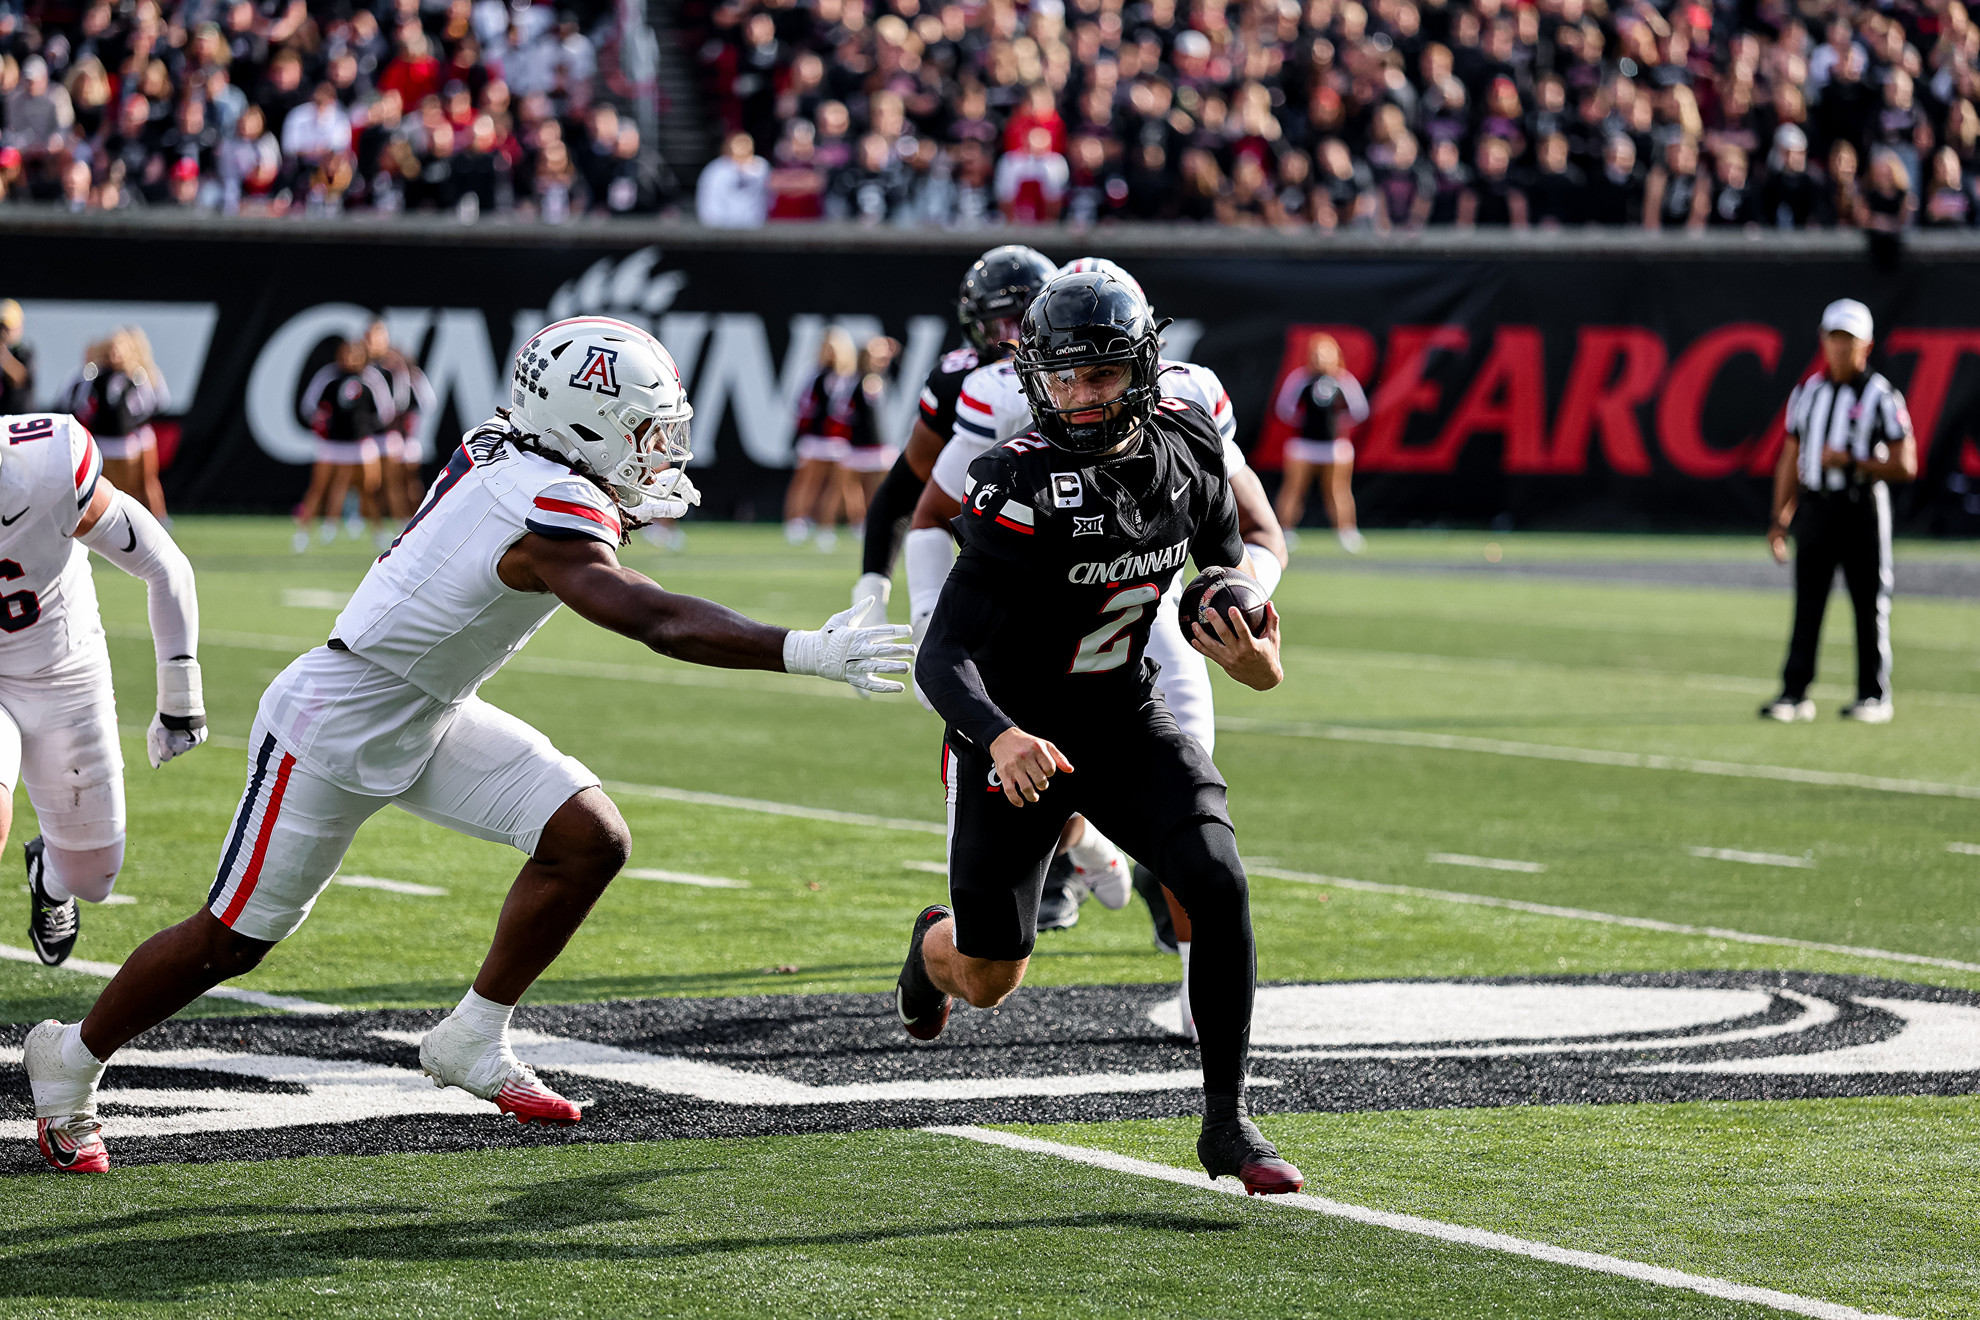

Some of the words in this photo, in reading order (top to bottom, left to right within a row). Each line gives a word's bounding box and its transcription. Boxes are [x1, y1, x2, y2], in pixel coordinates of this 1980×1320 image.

[568, 345, 622, 398] A
[9, 417, 53, 446] 16
[1001, 431, 1051, 456] 2
[1054, 475, 1080, 498] C
[1068, 537, 1189, 585] CINCINNATI
[1067, 582, 1160, 674] 2
